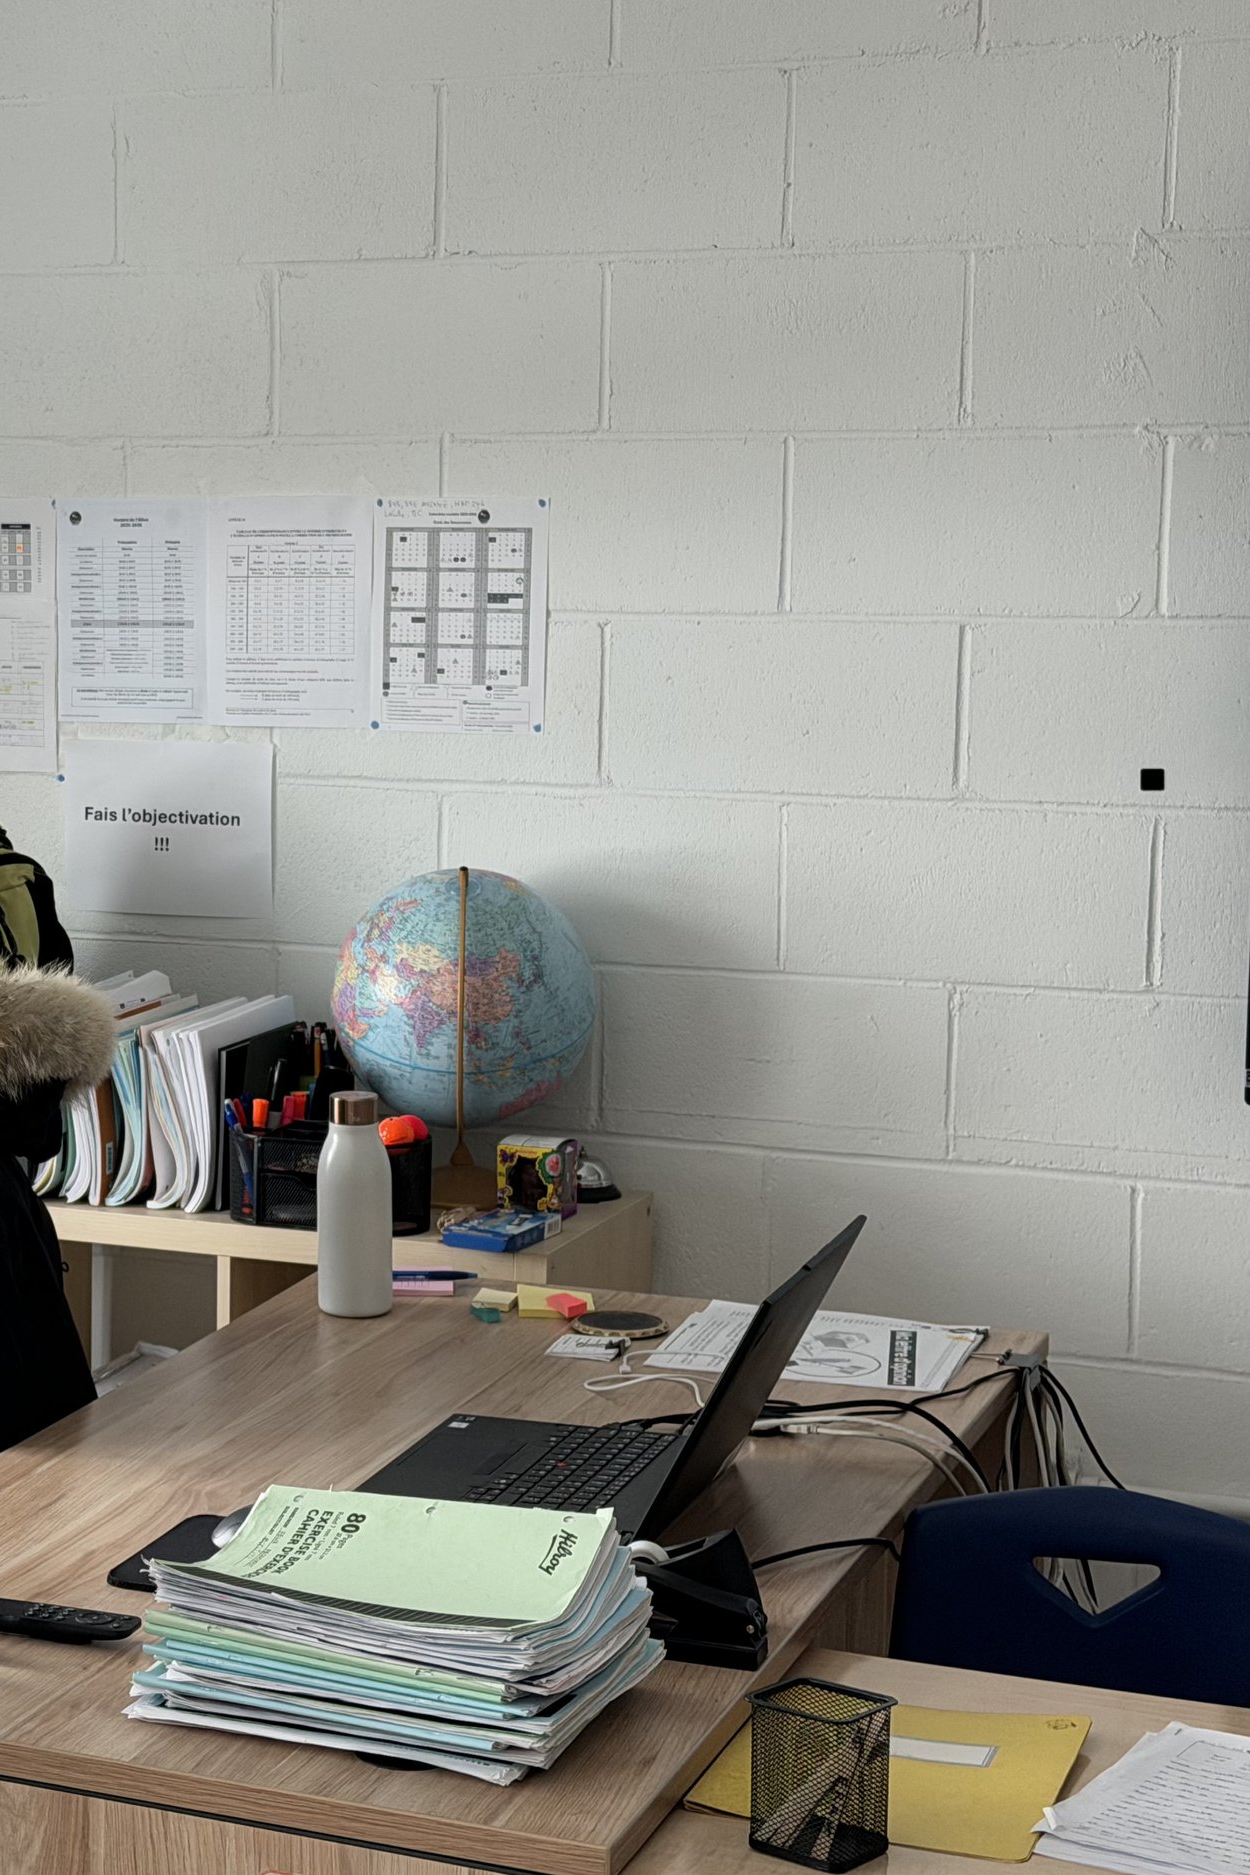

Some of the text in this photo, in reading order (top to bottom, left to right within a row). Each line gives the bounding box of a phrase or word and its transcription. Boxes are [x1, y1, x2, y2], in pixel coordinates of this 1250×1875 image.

[84, 806, 241, 827] Fais l'objectivation
[154, 836, 170, 852] !!!
[287, 1508, 320, 1545] CAHIER
[294, 1510, 334, 1556] EXERCISE
[340, 1512, 367, 1534] 80
[538, 1528, 578, 1576] Hilroy
[270, 1556, 301, 1575] BOOK
